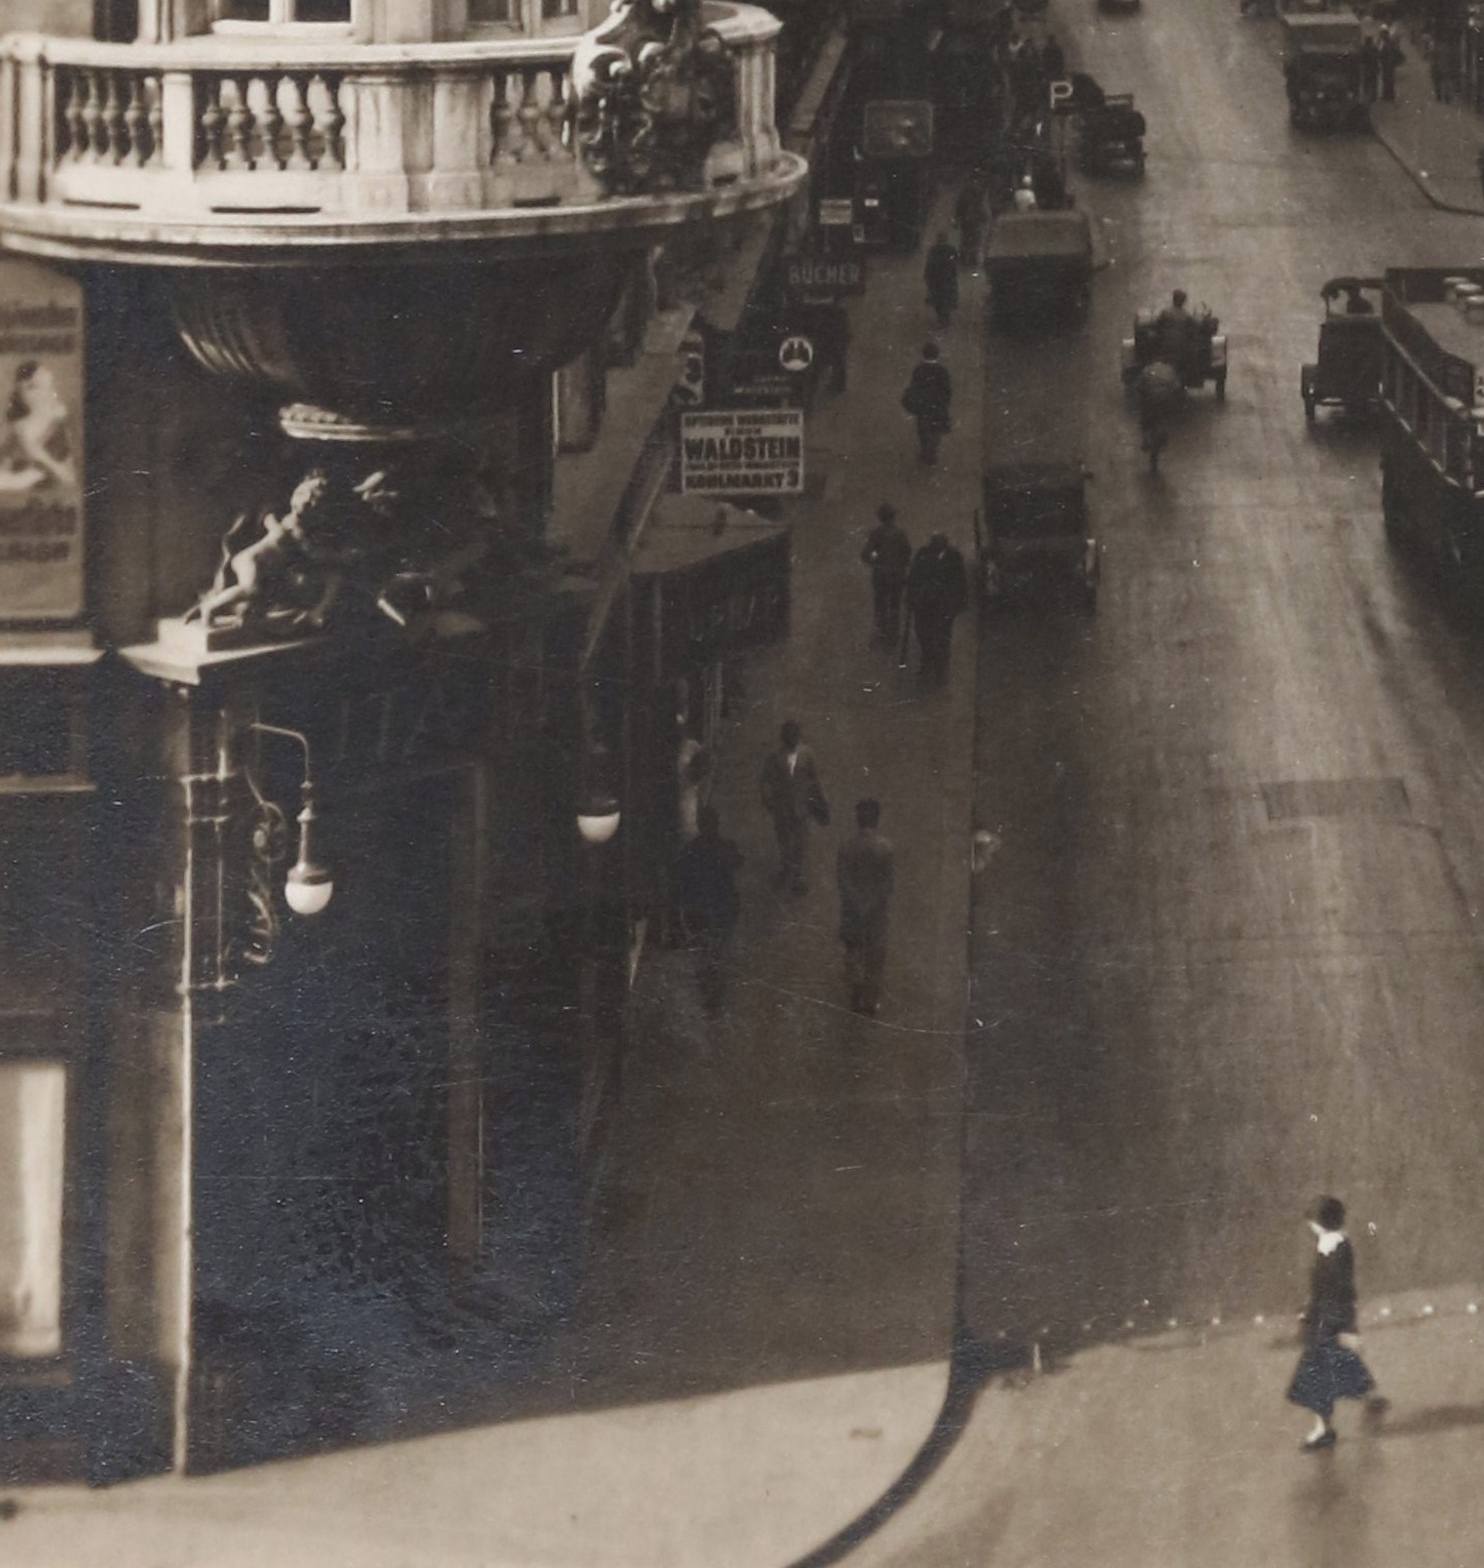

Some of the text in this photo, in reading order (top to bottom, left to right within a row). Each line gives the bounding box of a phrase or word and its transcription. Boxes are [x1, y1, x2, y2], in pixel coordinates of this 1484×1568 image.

[1050, 80, 1073, 109] P
[684, 436, 801, 461] WALDSTEIN
[684, 473, 785, 489] KOHLMARKT
